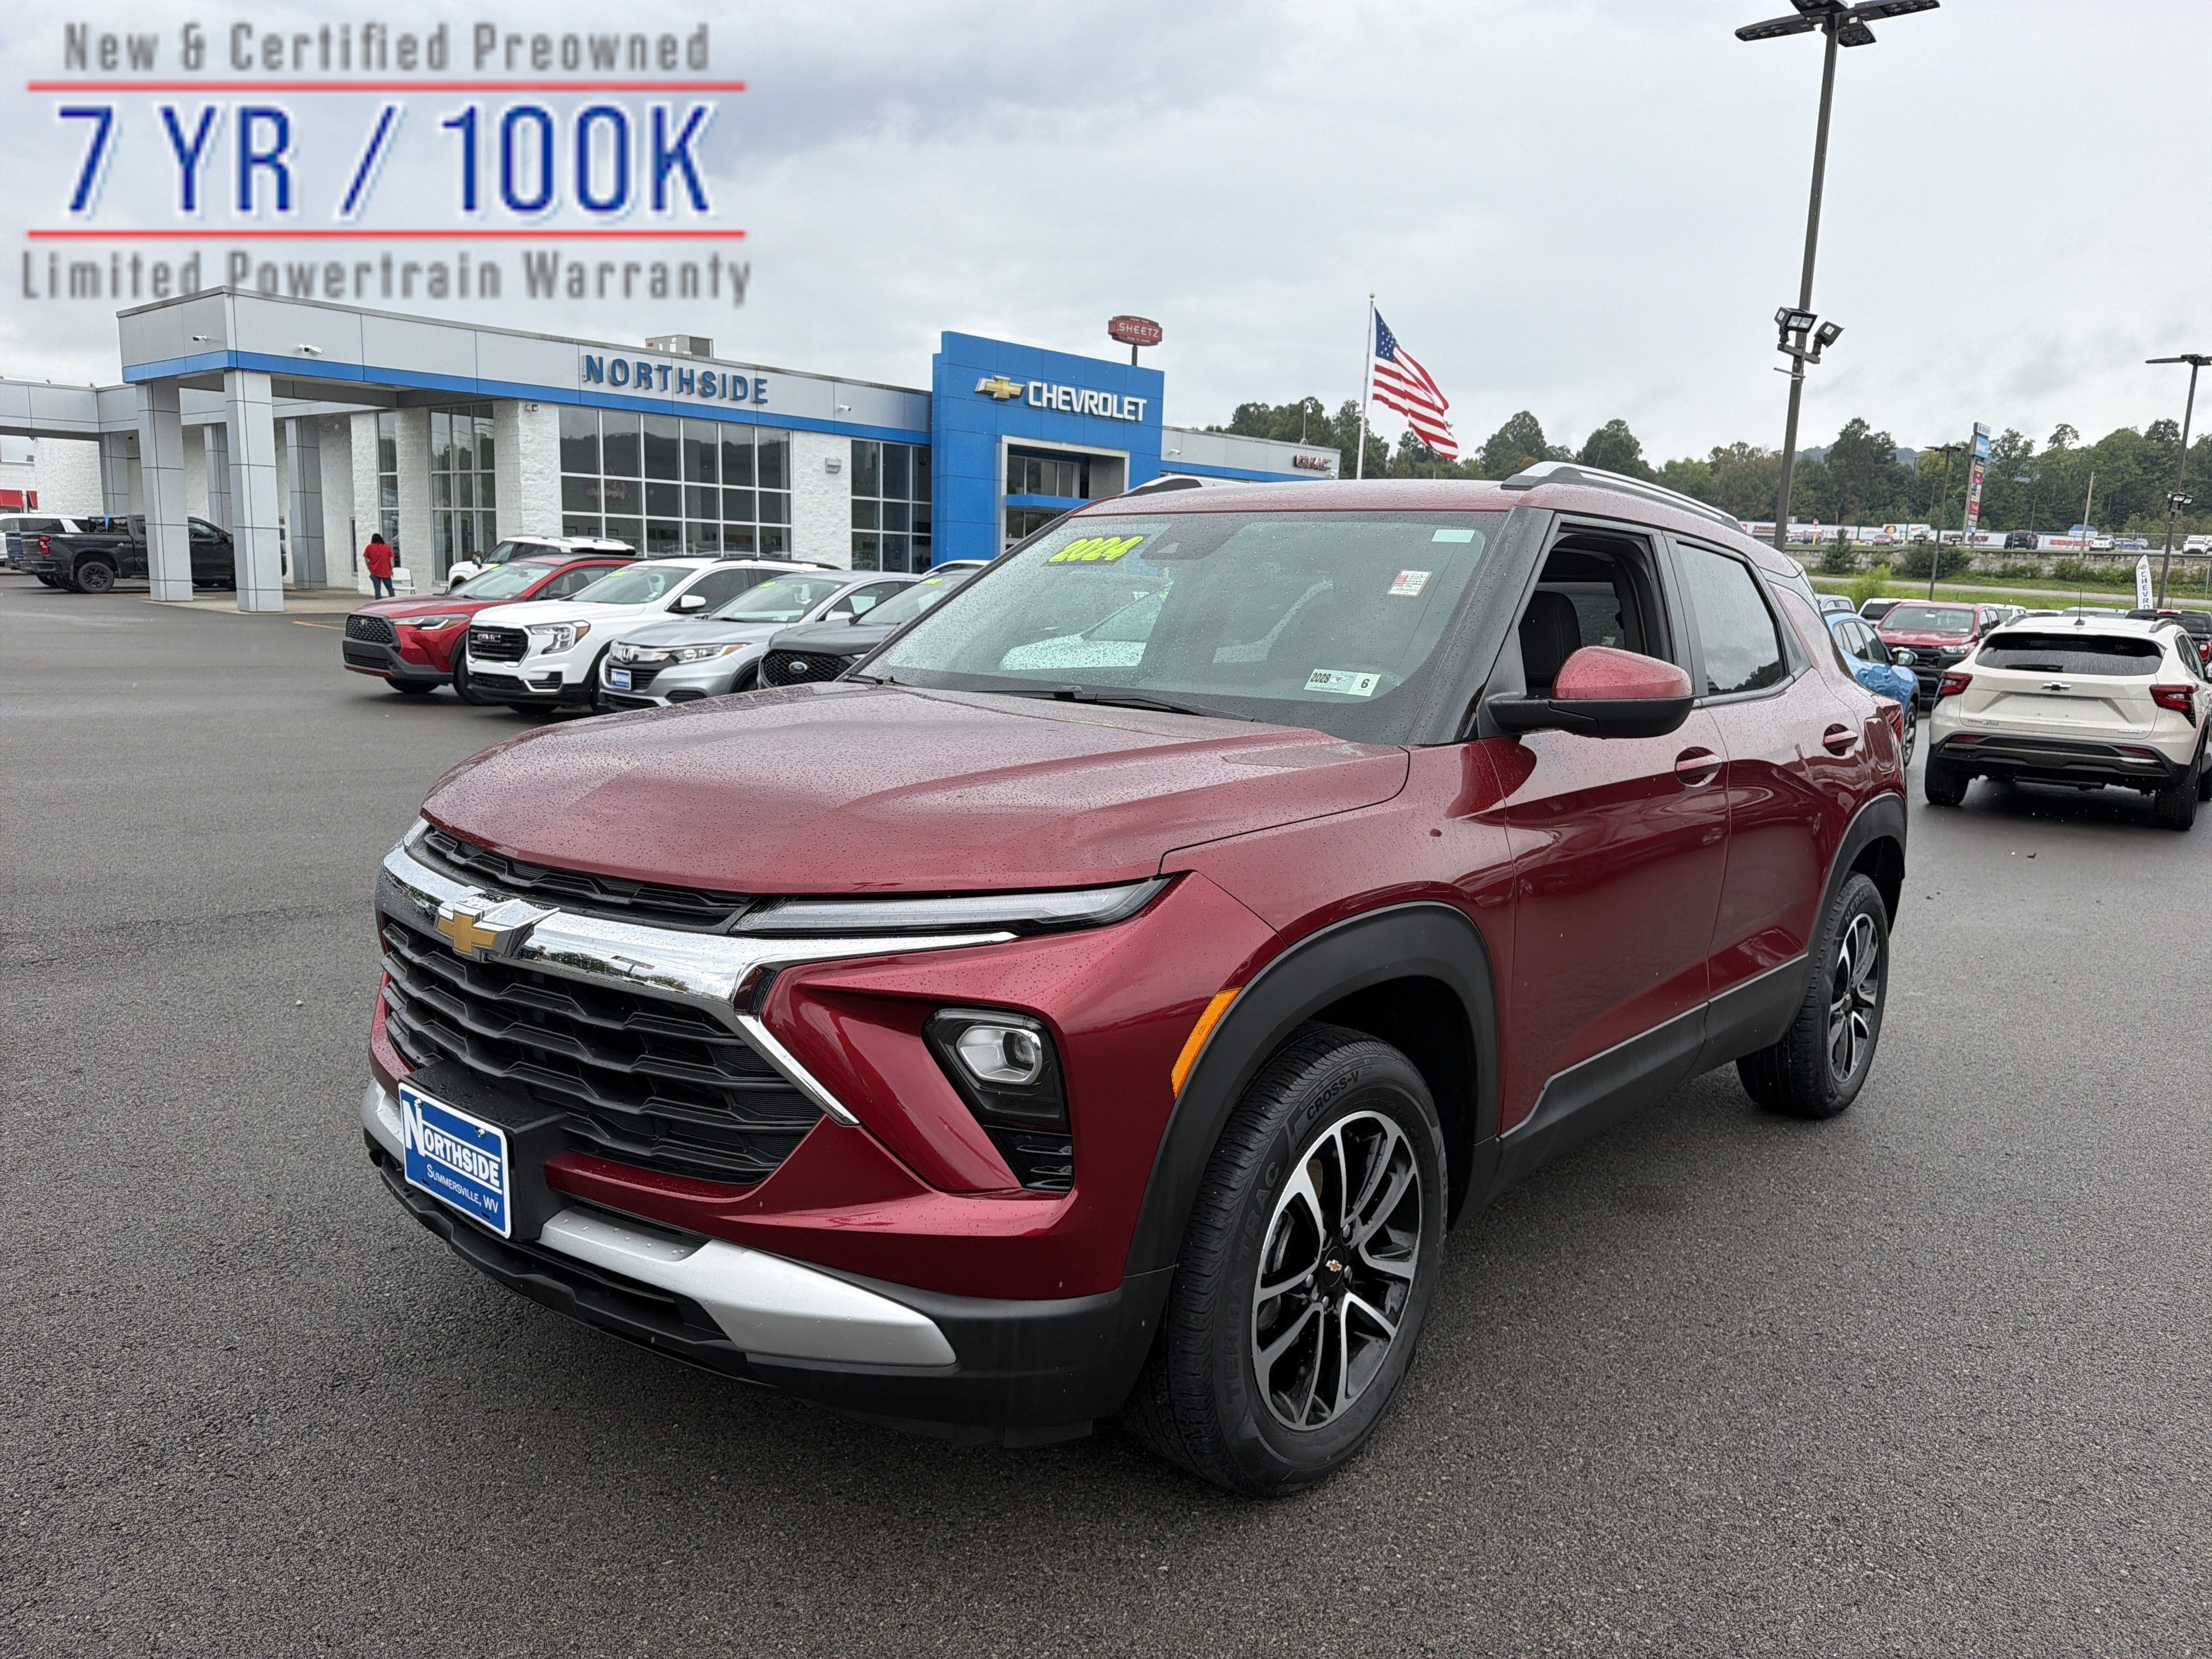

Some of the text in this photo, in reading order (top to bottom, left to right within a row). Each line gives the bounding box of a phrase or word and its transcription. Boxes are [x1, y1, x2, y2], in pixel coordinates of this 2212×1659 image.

[1119, 323, 1159, 338] SHEETZ
[583, 354, 768, 404] NORTHSIDE
[1028, 381, 1147, 421] CHEVROLET
[1296, 455, 1332, 470] GMC
[1048, 535, 1144, 562] 2024
[1310, 672, 1370, 689] 2028 6
[1306, 1070, 1359, 1120] CROSS-V
[402, 1099, 500, 1187] NORTHSIDE
[426, 1164, 499, 1214] SUMMERSVILLE, WV
[1239, 1161, 1280, 1259] TRAC
